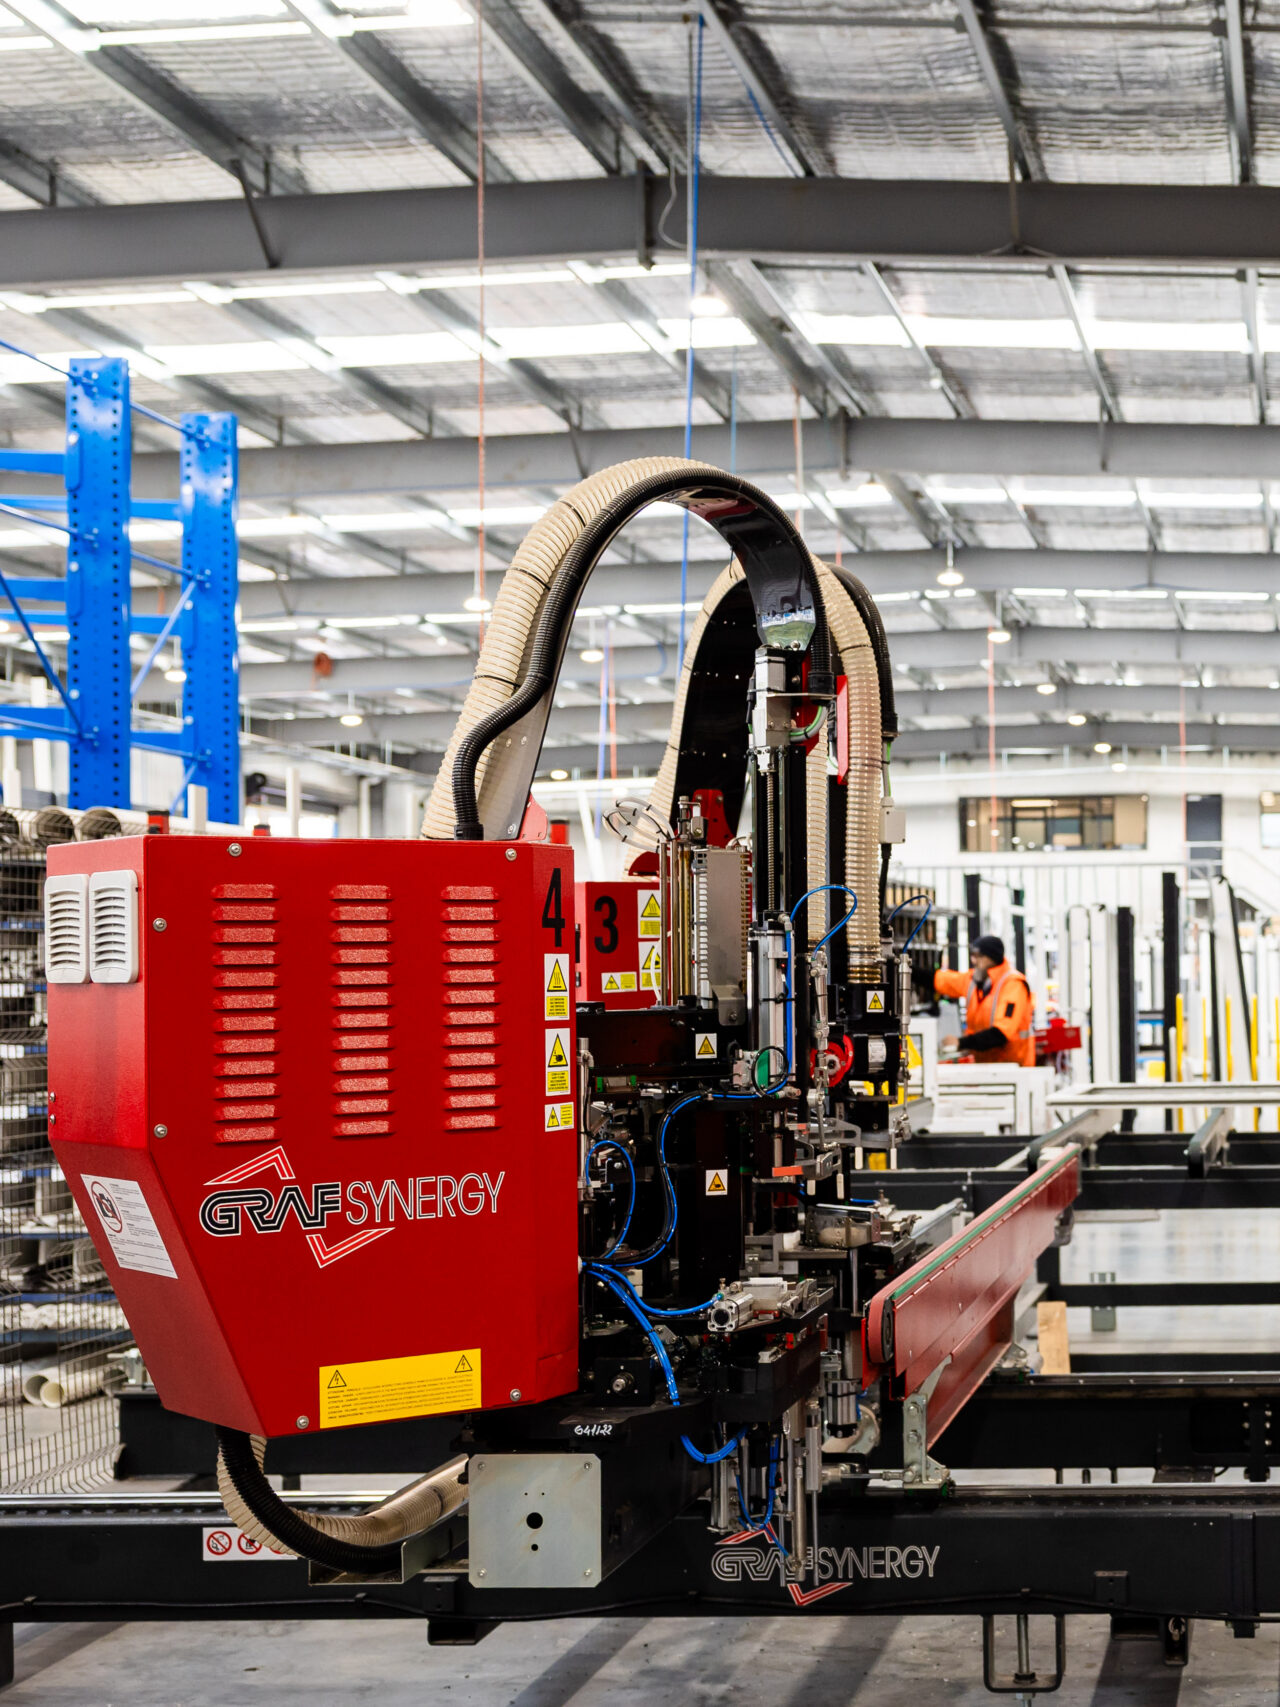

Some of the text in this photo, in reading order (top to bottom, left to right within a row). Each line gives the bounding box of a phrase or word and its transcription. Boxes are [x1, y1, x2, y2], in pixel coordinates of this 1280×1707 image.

[542, 868, 565, 947] 4
[594, 896, 618, 954] 3
[199, 1182, 341, 1237] GRAF
[346, 1171, 505, 1225] SYNERGY
[818, 1545, 940, 1580] SYNERGY
